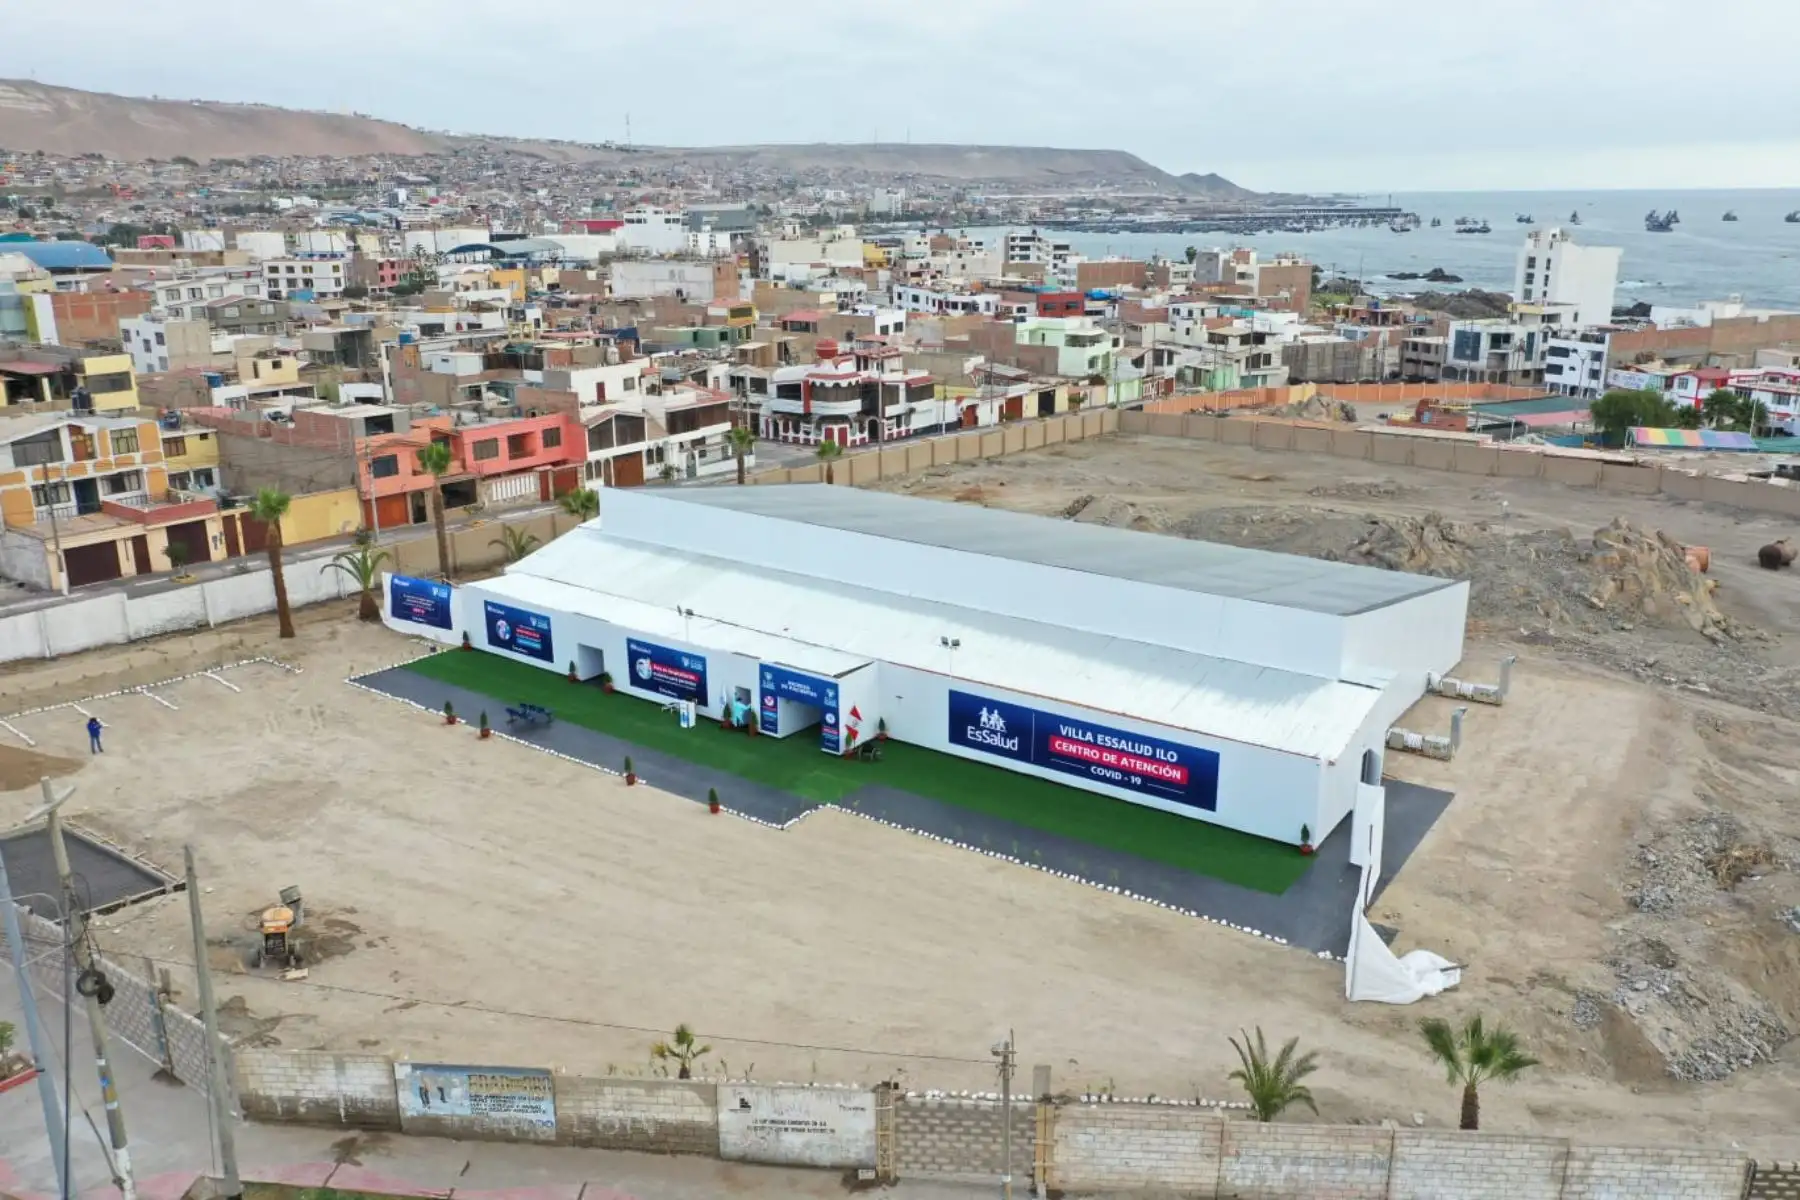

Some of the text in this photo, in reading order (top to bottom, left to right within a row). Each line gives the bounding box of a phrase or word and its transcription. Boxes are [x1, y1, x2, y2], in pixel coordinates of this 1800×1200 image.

[967, 725, 1019, 751] EsSalud
[1059, 724, 1178, 763] VILLA ESSALUD ILO
[1054, 740, 1181, 780] CENTRO DE ATENCIÓN
[1090, 765, 1122, 781] COVID
[1130, 775, 1142, 786] 19
